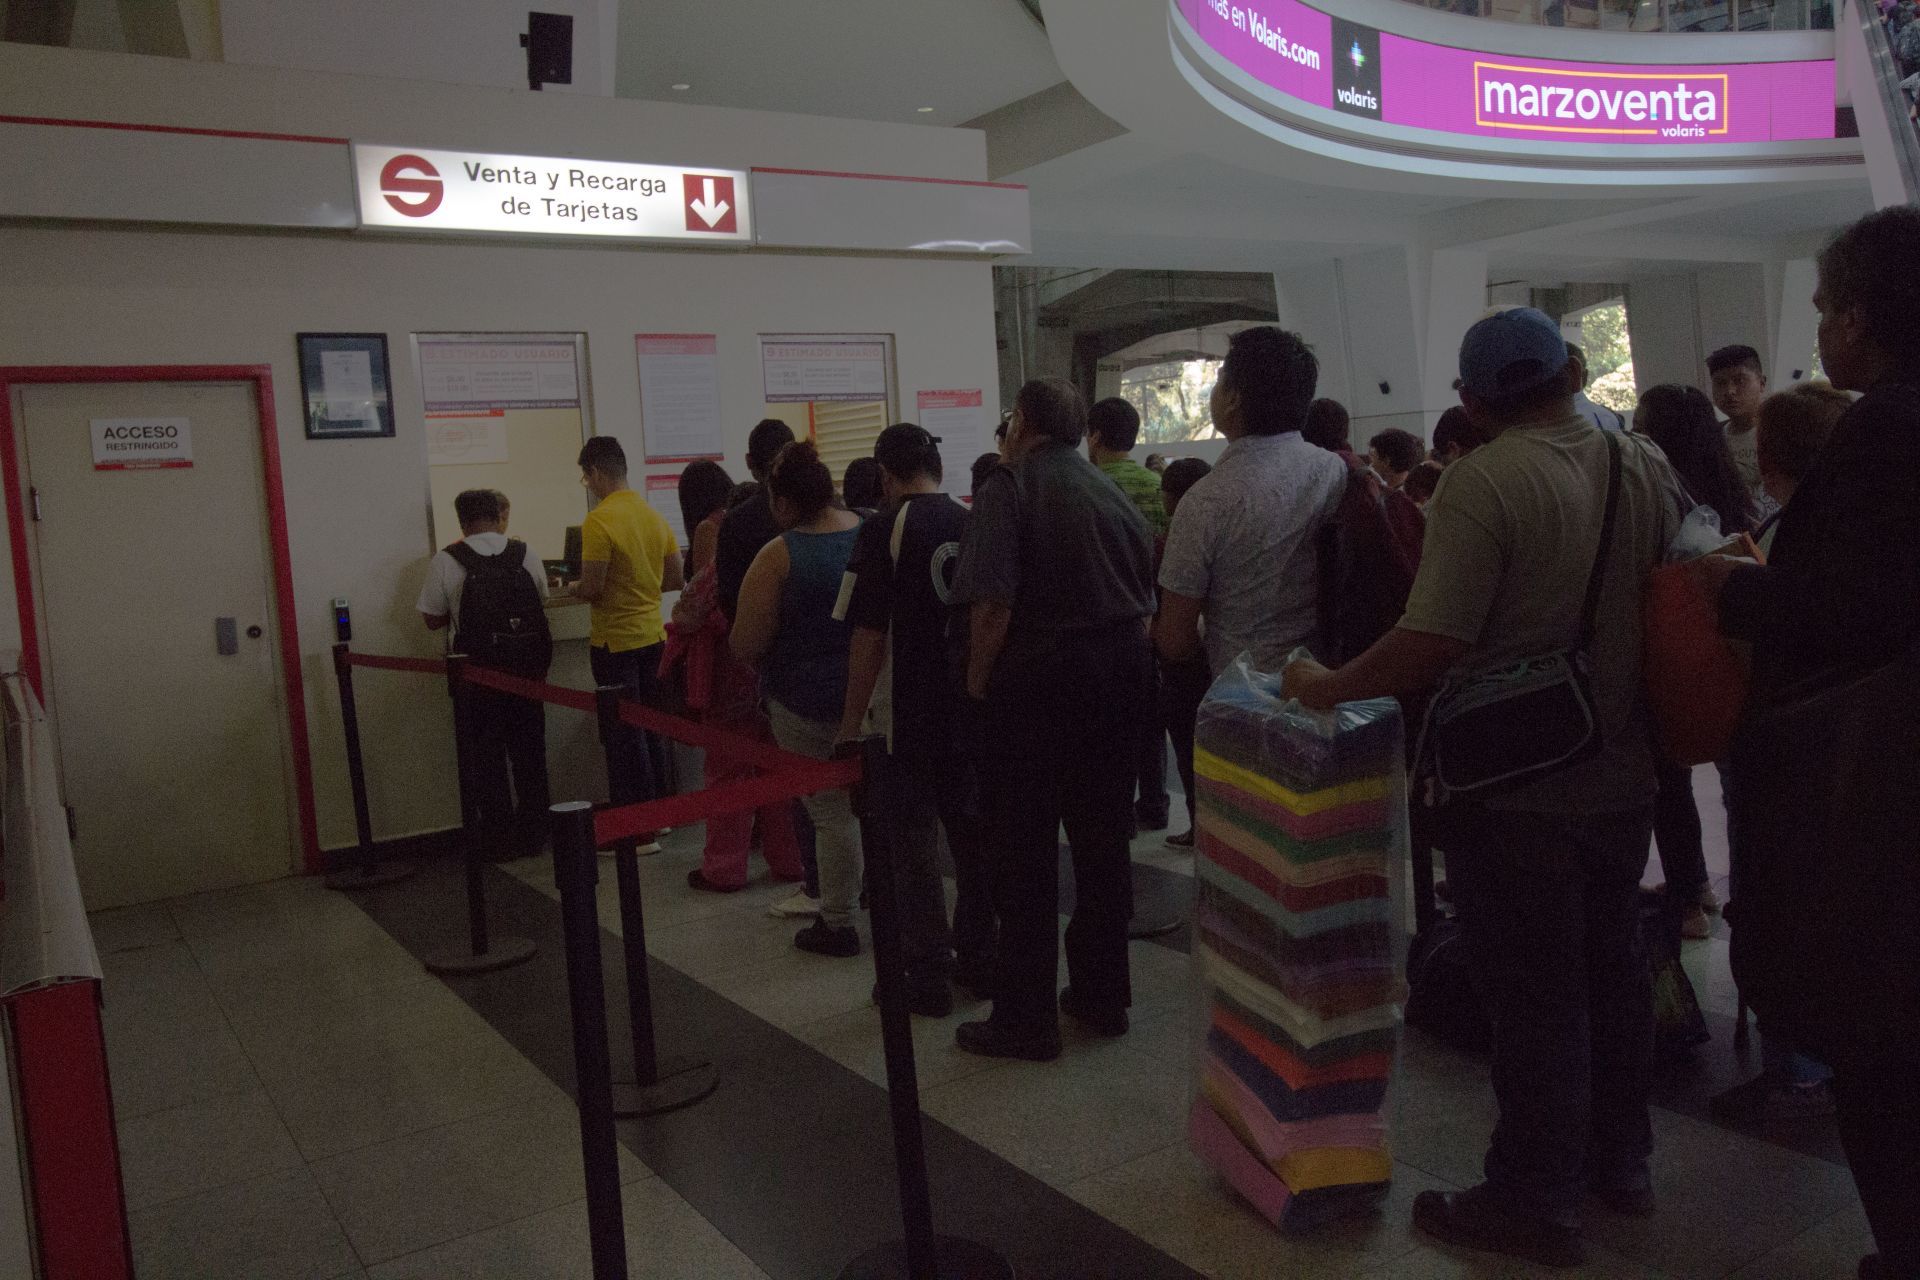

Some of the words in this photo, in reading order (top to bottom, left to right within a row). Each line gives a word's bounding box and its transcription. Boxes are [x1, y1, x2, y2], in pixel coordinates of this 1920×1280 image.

[1231, 6, 1246, 32] en
[1248, 8, 1320, 70] Volaris.com
[1337, 87, 1378, 110] volaris
[1483, 79, 1717, 122] marzoventa
[1661, 124, 1706, 138] volaris
[463, 161, 538, 185] Venta
[546, 171, 560, 189] y
[569, 169, 667, 196] Recarga
[501, 196, 531, 216] de
[540, 197, 639, 223] Tarjetas
[104, 425, 178, 439] ACCESO
[106, 441, 179, 452] RESTRINGIDO
